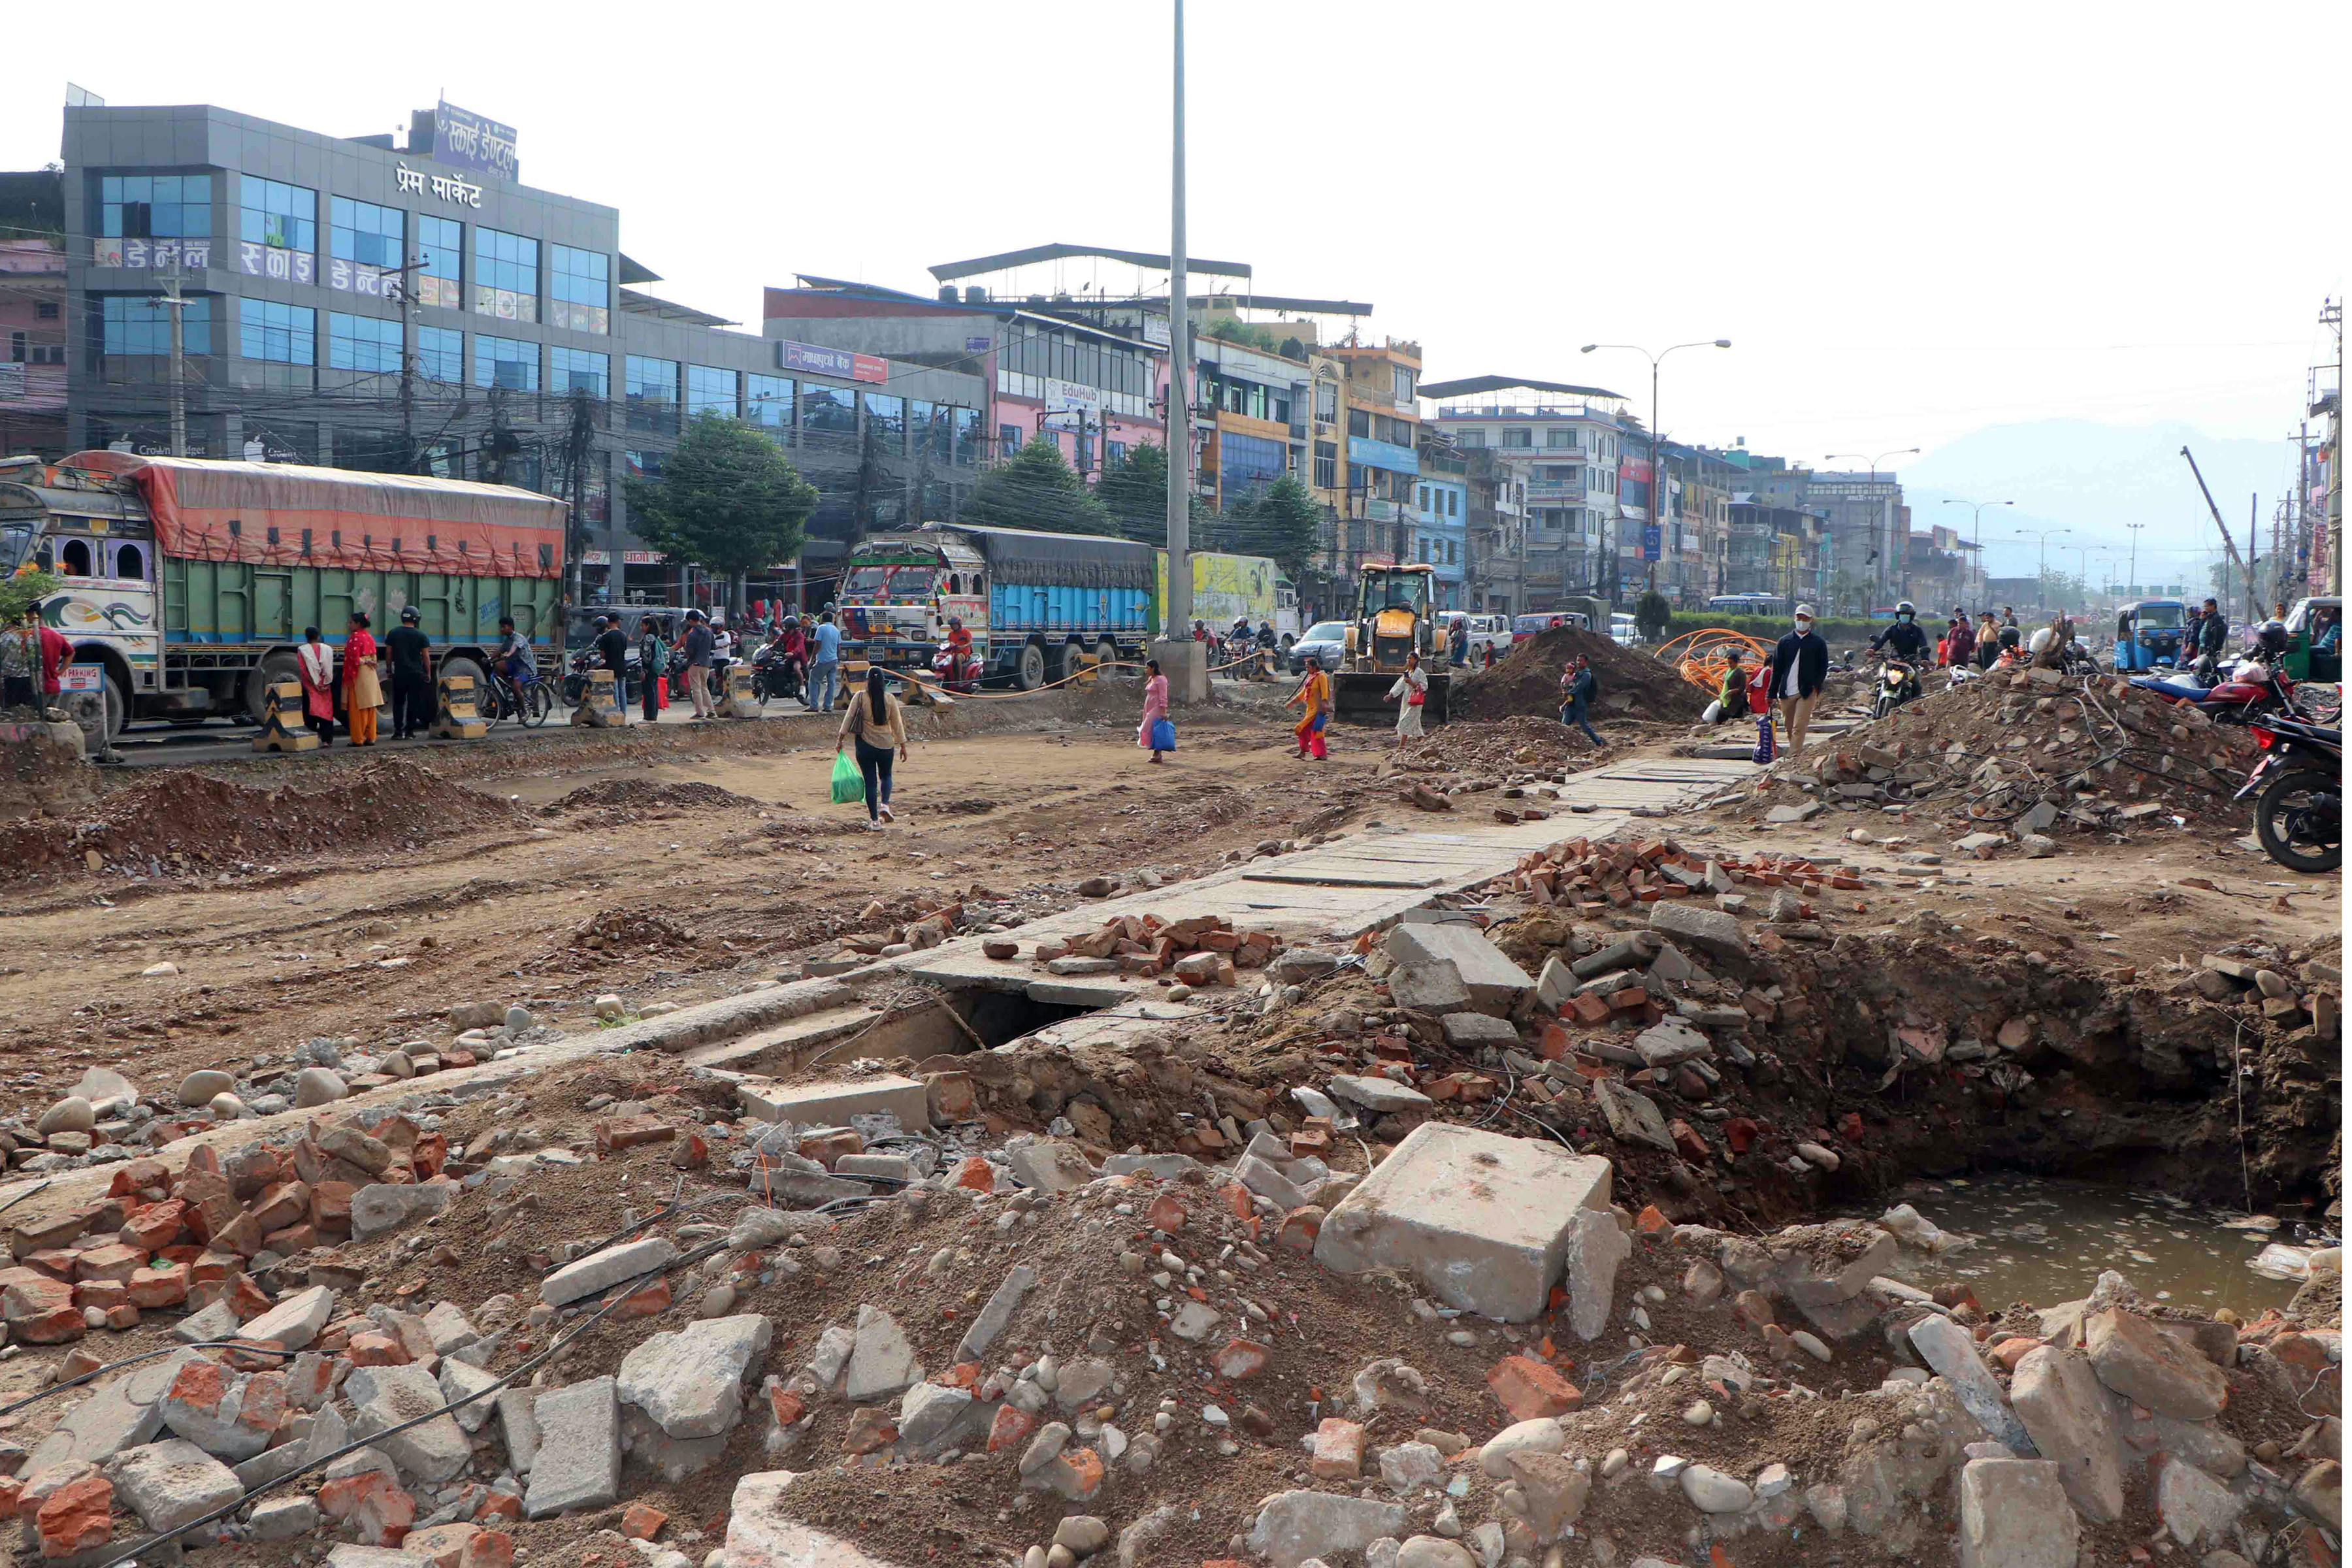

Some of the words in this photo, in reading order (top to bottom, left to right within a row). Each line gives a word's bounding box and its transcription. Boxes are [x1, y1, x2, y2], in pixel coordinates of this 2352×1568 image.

[448, 120, 480, 161] स्काई
[396, 161, 425, 195] प्रेम
[431, 173, 482, 208] मार्केट
[1062, 383, 1096, 402] EduHub
[185, 446, 206, 456] dget
[68, 668, 97, 678] PARKING
